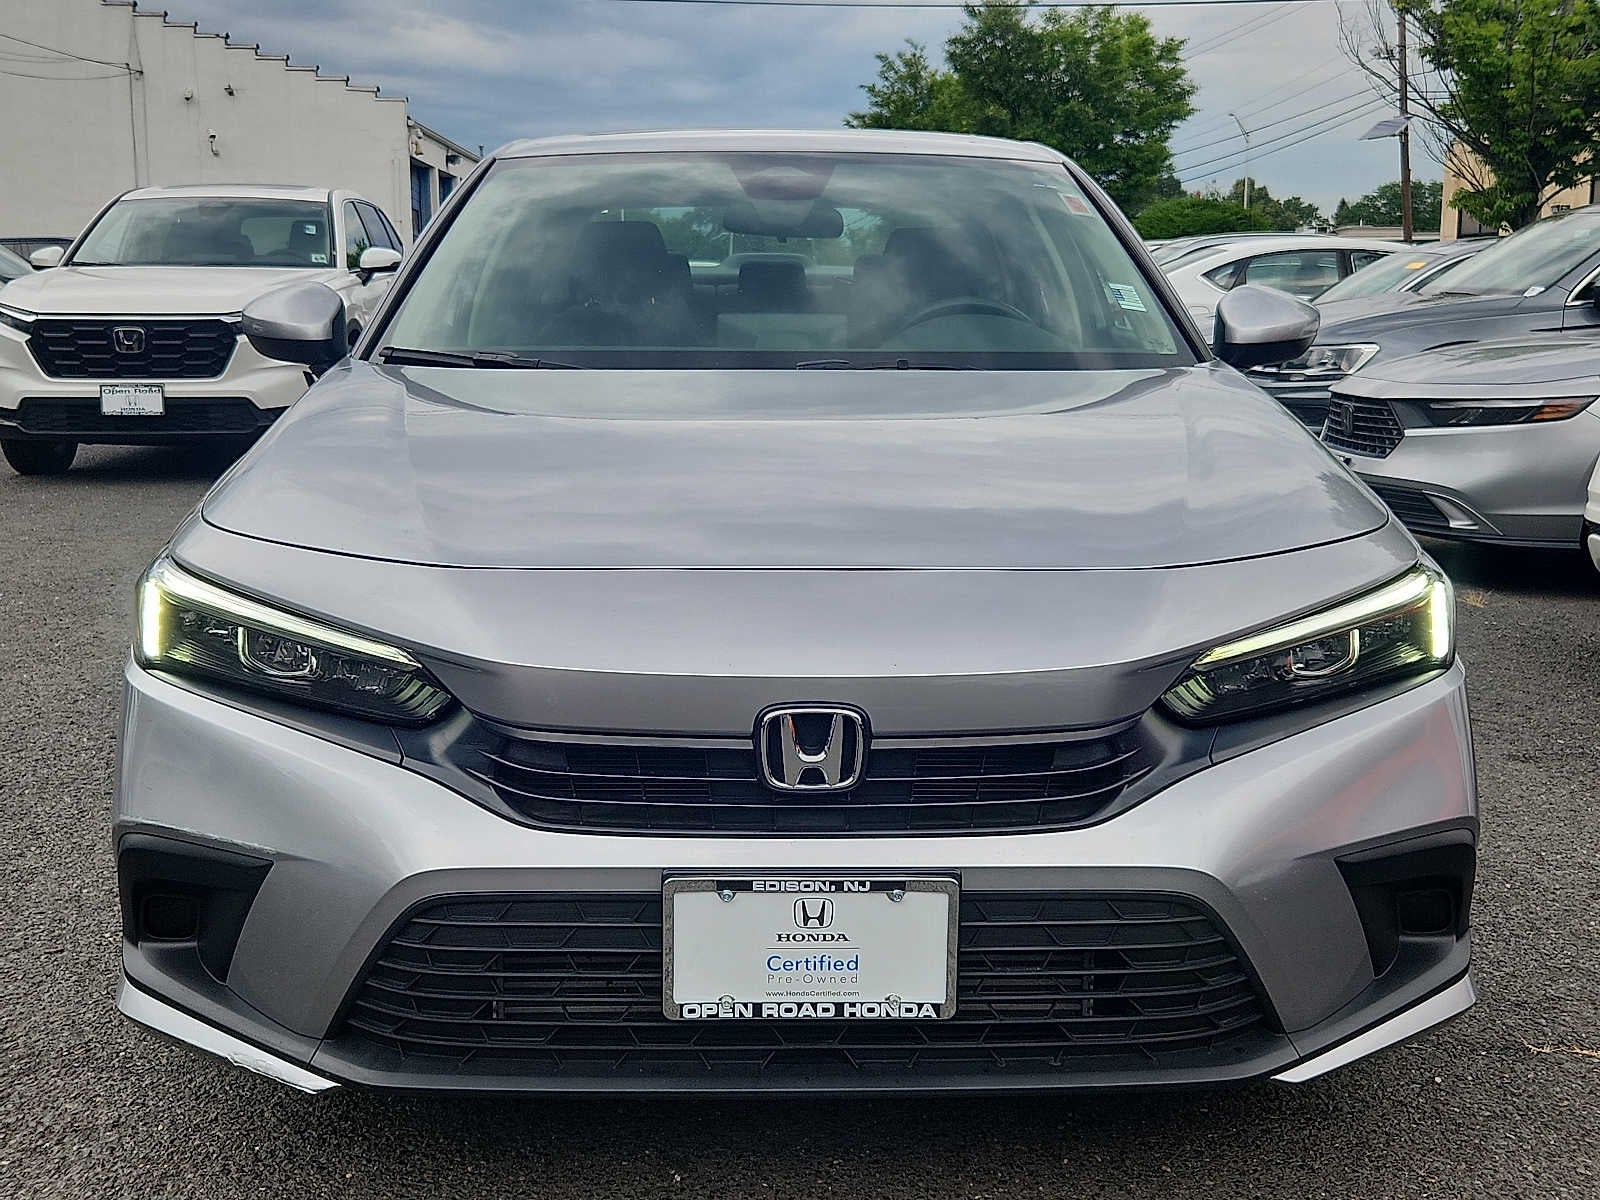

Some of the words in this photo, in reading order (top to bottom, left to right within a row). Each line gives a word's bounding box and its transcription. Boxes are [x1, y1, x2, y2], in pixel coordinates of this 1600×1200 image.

[752, 880, 836, 892] EDISON,
[843, 880, 871, 892] NJ
[776, 933, 851, 942] HONDA
[766, 954, 859, 971] Certified
[767, 973, 858, 984] Pre-Owned
[682, 1003, 753, 1018] OPEN
[761, 1003, 835, 1018] ROAD
[843, 1003, 937, 1018] HONDA
